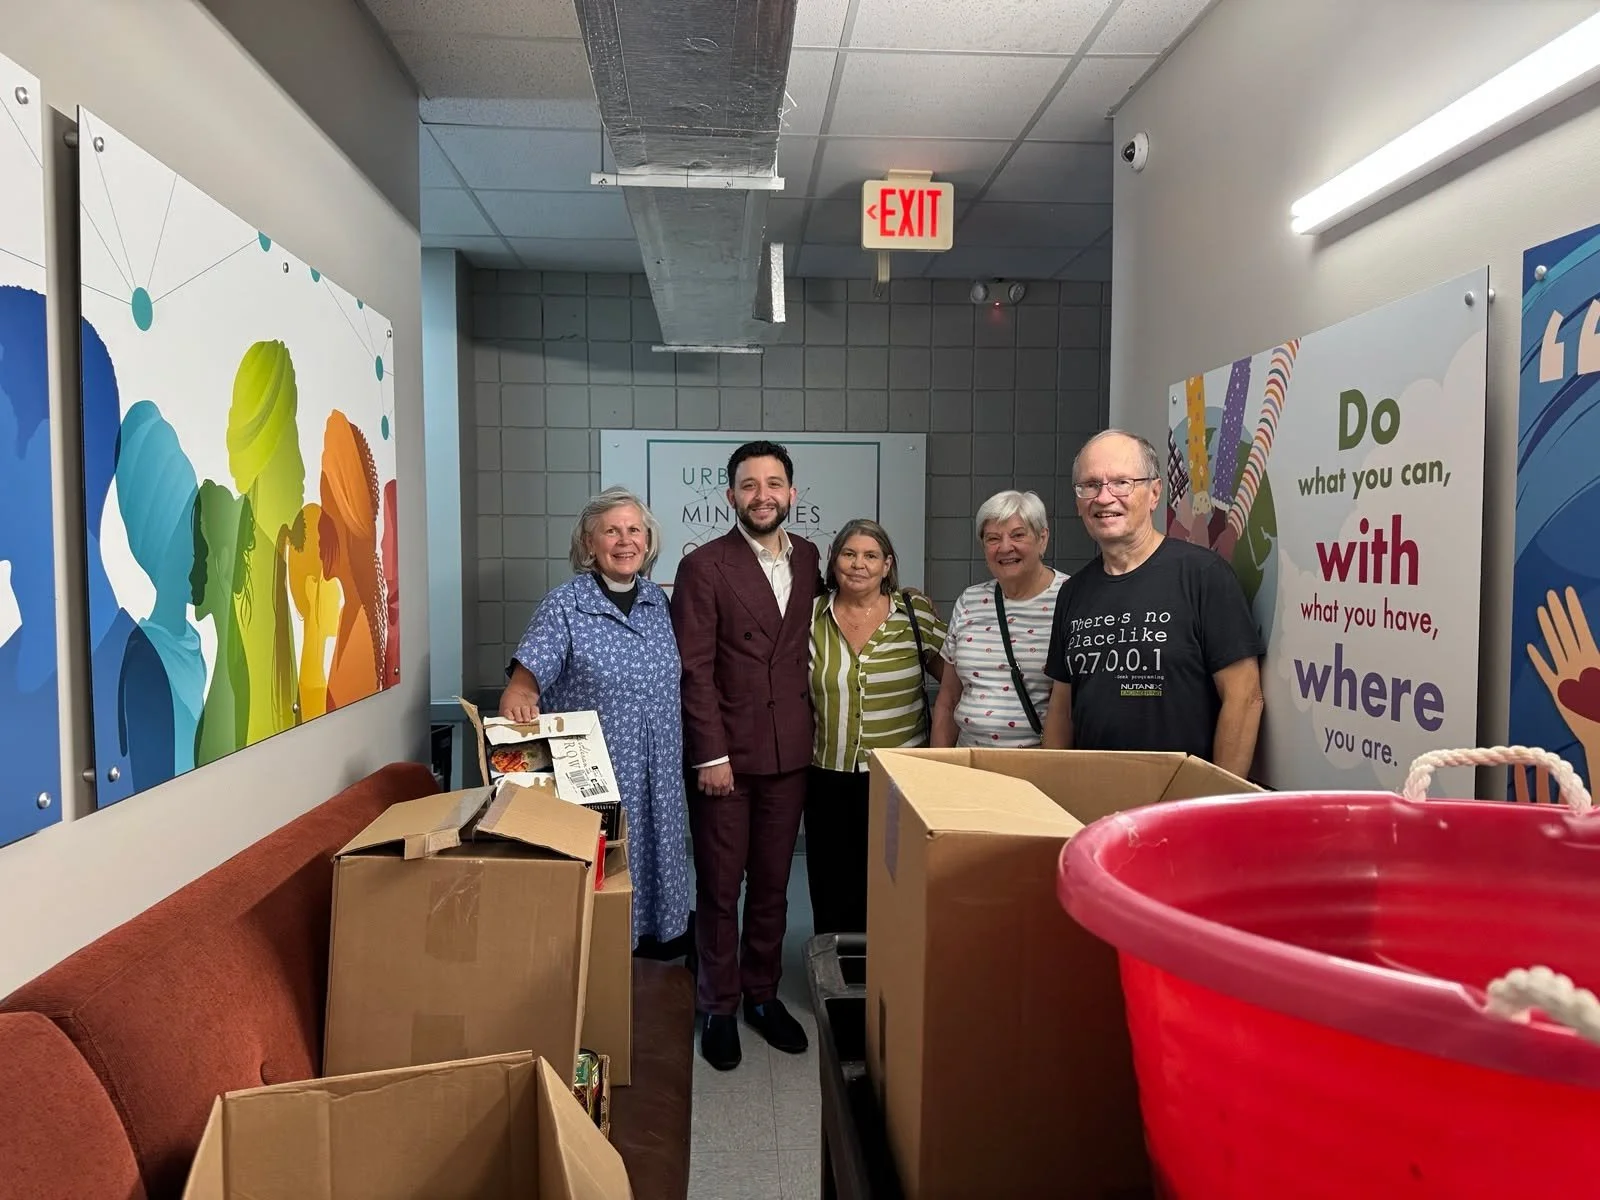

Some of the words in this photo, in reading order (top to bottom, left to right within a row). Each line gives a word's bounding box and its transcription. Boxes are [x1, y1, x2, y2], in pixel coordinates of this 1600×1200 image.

[880, 189, 942, 237] EXIT
[1338, 388, 1401, 450] Do
[682, 467, 729, 485] URB
[1298, 467, 1346, 496] what
[1352, 466, 1393, 499] you
[1401, 459, 1451, 488] can,
[682, 505, 820, 523] MINIIES
[1316, 514, 1419, 586] with
[1070, 611, 1131, 634] There's
[1144, 611, 1171, 623] no
[1300, 593, 1339, 624] what
[1344, 603, 1375, 632] you
[1383, 597, 1439, 640] have,
[1066, 648, 1161, 676] 127.0.0.1
[1294, 642, 1445, 732] where
[1324, 726, 1355, 754] you
[1362, 737, 1398, 767] are.
